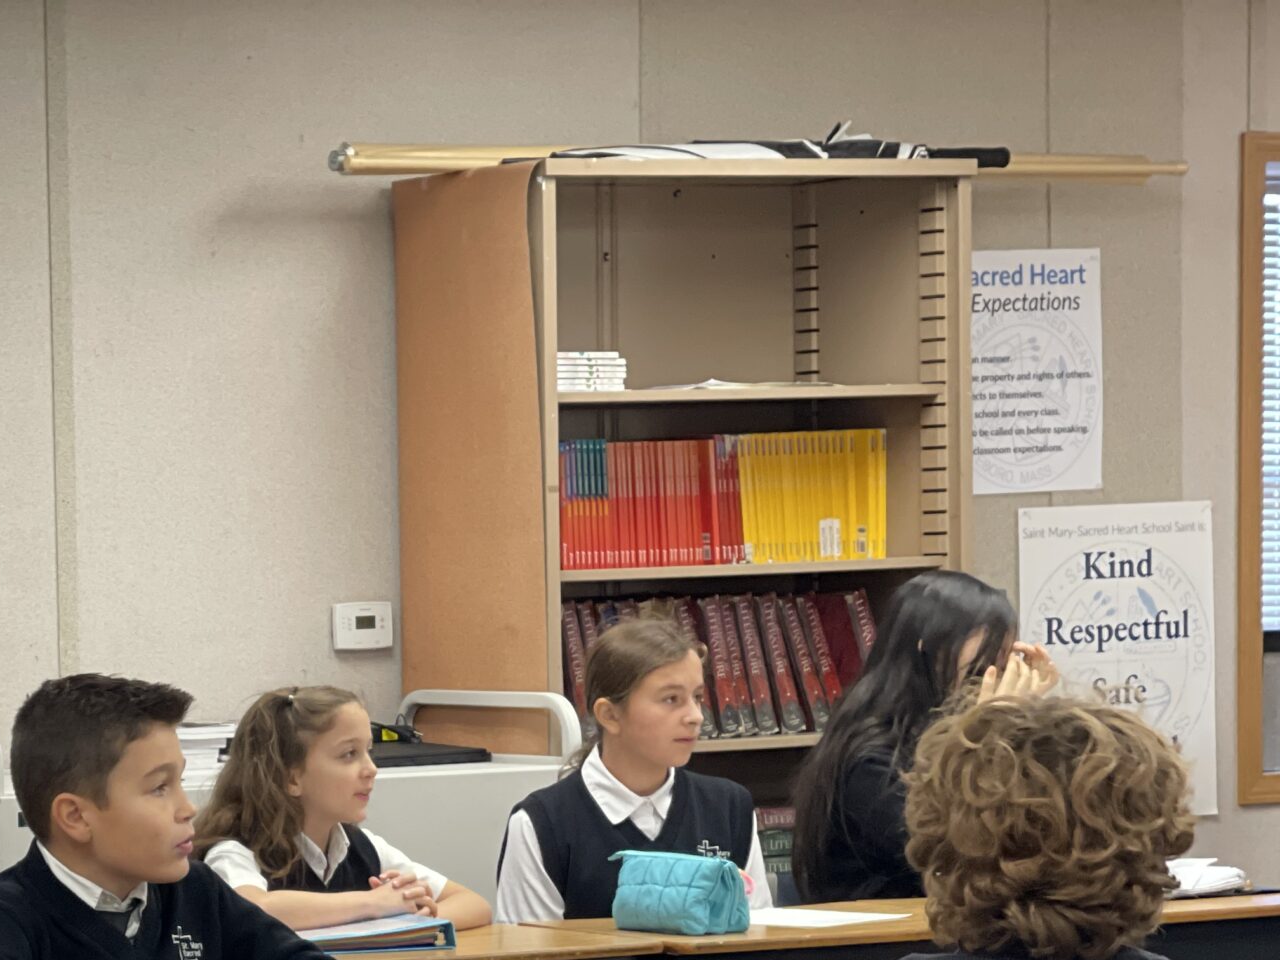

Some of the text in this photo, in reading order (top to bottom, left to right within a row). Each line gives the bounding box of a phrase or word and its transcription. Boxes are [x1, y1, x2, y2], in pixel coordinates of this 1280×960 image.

[1030, 263, 1086, 285] Heart
[971, 291, 1081, 317] Expectations
[981, 374, 1014, 383] property
[1016, 371, 1031, 380] and
[1033, 371, 1054, 381] rights
[989, 392, 997, 400] to
[974, 410, 999, 418] school
[1001, 409, 1016, 417] and
[1017, 409, 1039, 417] every
[979, 429, 989, 437] be
[991, 427, 1013, 436] called
[1026, 426, 1052, 435] before
[972, 446, 1011, 455] classroom
[1022, 527, 1045, 539] Saint
[1048, 525, 1109, 540] Mary-Sacred
[1111, 524, 1139, 535] Heart
[1141, 522, 1173, 533] School
[1174, 521, 1196, 532] Saint
[1083, 548, 1153, 580] Kind
[706, 605, 727, 679] LITERATURE
[722, 604, 741, 676] LITERATURE
[739, 602, 761, 675] LITERATURE
[764, 602, 785, 674] LITERATURE
[785, 603, 812, 673] LITERATURE
[805, 602, 831, 672] LITERATURE
[1044, 608, 1190, 653] Respectful
[1093, 674, 1147, 705] Safe
